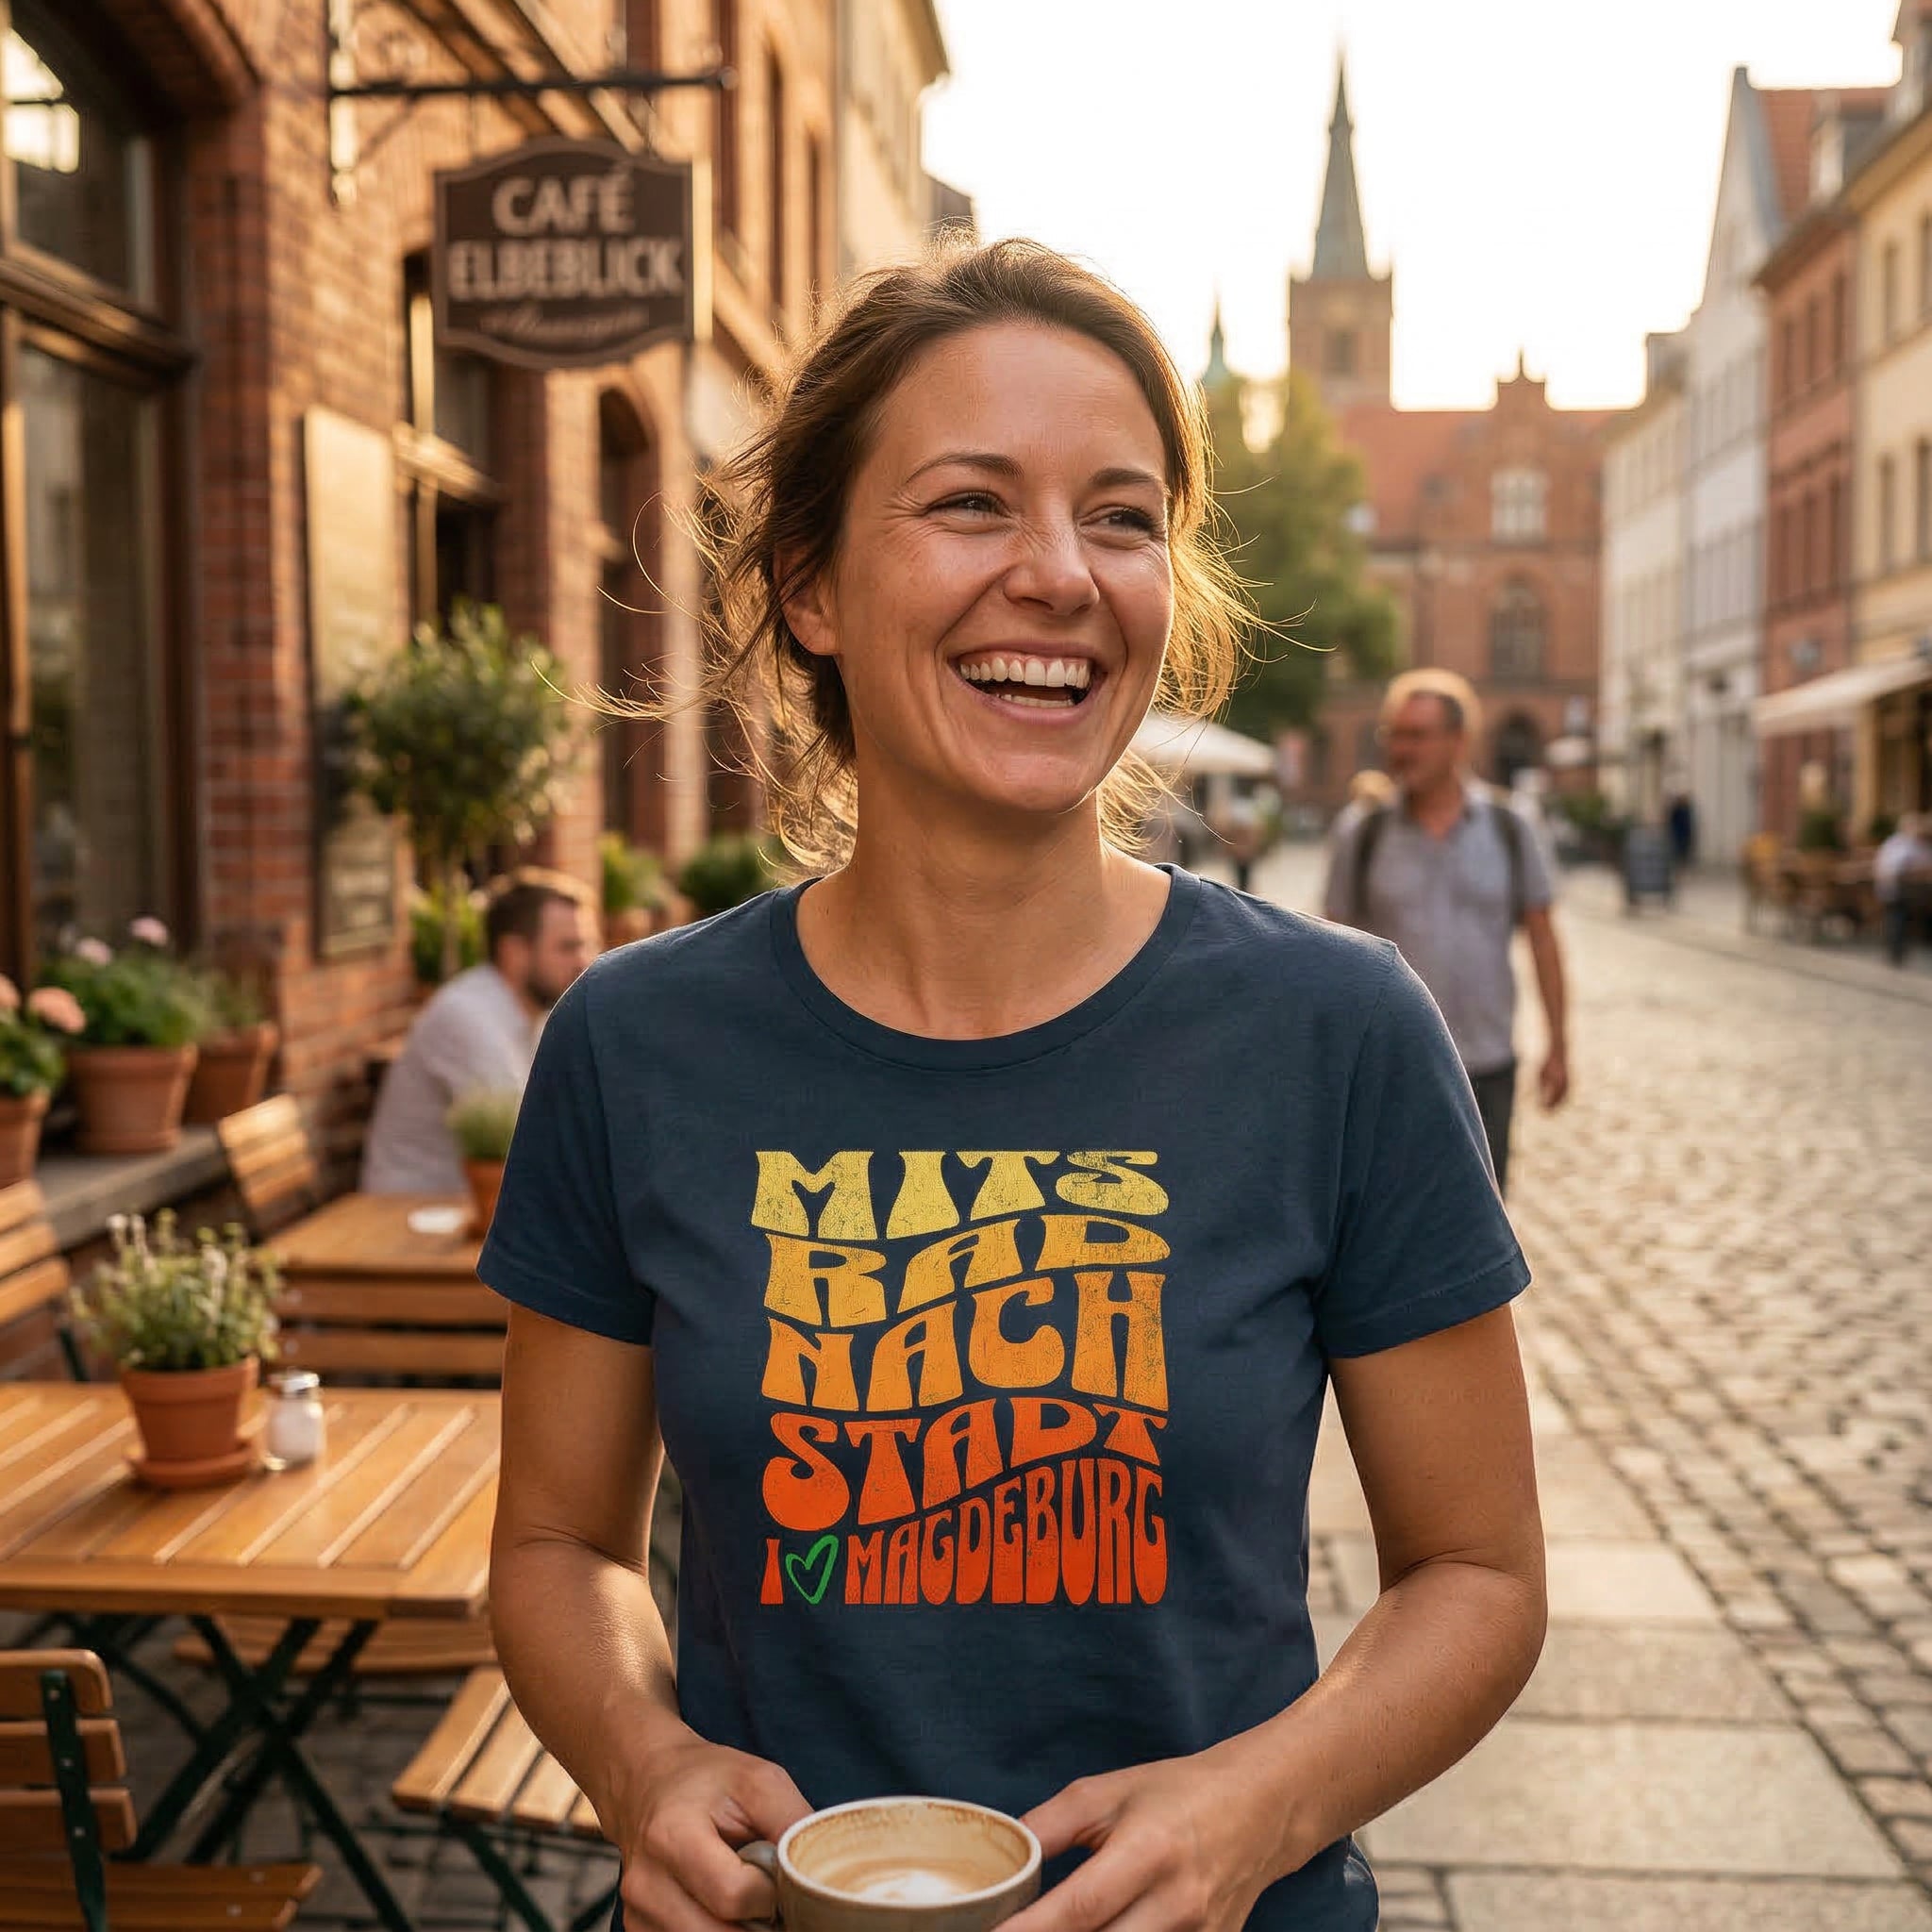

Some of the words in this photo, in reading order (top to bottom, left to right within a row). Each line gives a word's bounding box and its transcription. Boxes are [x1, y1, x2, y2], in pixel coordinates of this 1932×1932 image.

[492, 162, 636, 234] CAFÉ
[763, 1214, 1171, 1328] RAD
[761, 1271, 1169, 1412] NACH
[760, 1538, 784, 1605] I
[845, 1457, 1168, 1605] MAGDEBURG
[762, 1397, 1168, 1532] STADT
